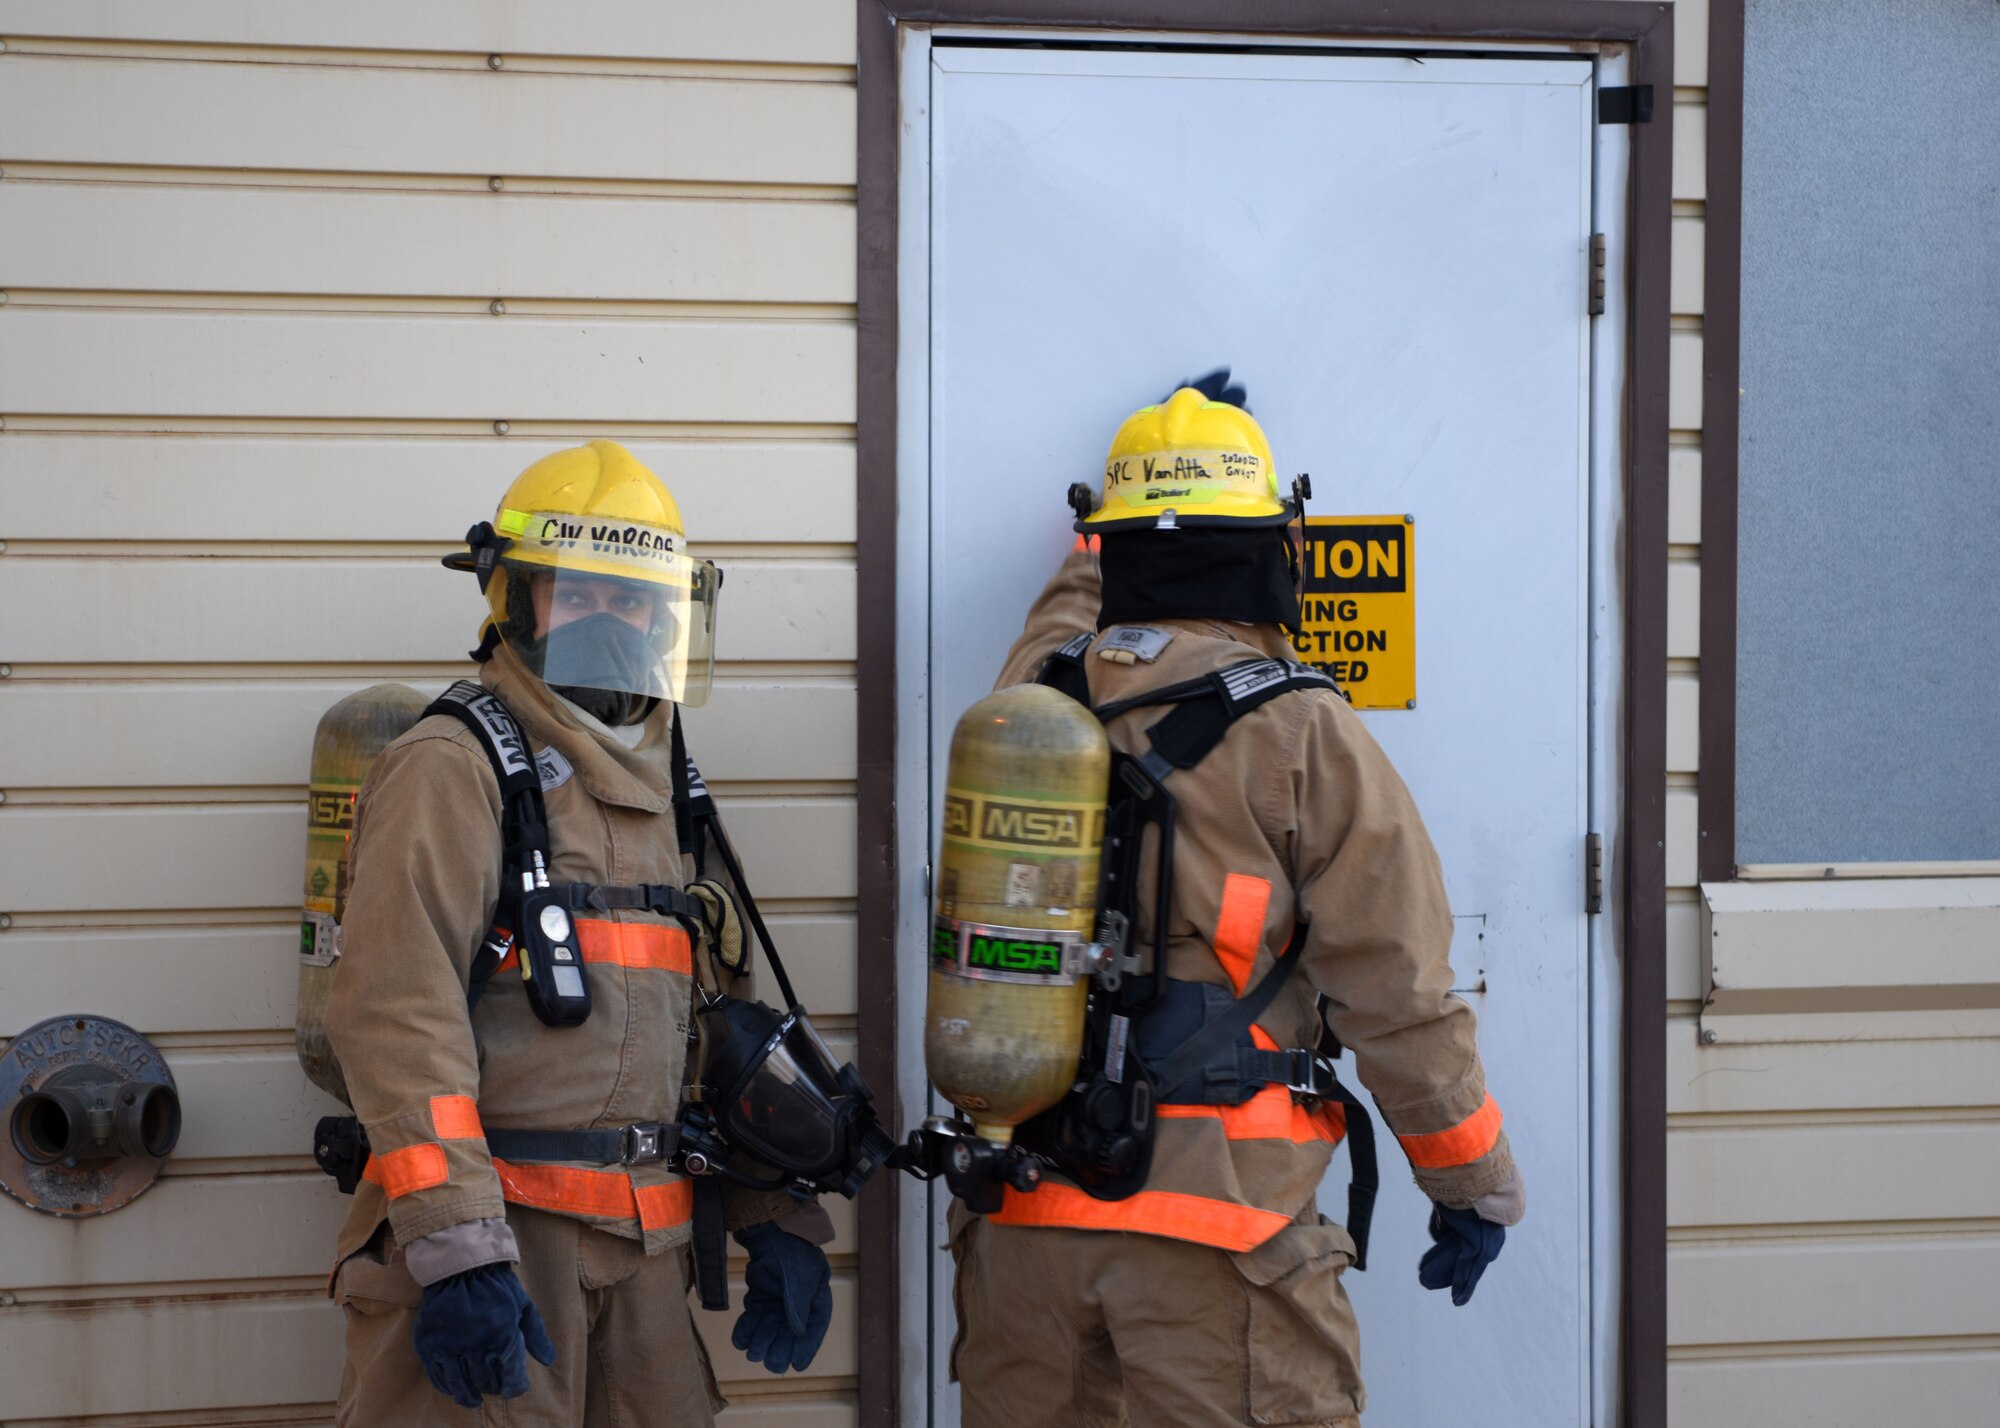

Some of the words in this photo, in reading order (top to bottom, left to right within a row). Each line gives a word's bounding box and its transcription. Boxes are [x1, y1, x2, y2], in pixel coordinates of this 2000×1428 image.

[1106, 461, 1133, 490] SPC
[540, 518, 584, 549] CIV
[591, 525, 675, 564] VARGAS
[1305, 539, 1399, 579] ION
[1301, 600, 1358, 623] ING
[1291, 630, 1387, 653] CTION
[477, 697, 532, 767] MSA
[312, 797, 357, 824] SA
[986, 808, 1080, 843] MSA
[970, 939, 1061, 971] MSA
